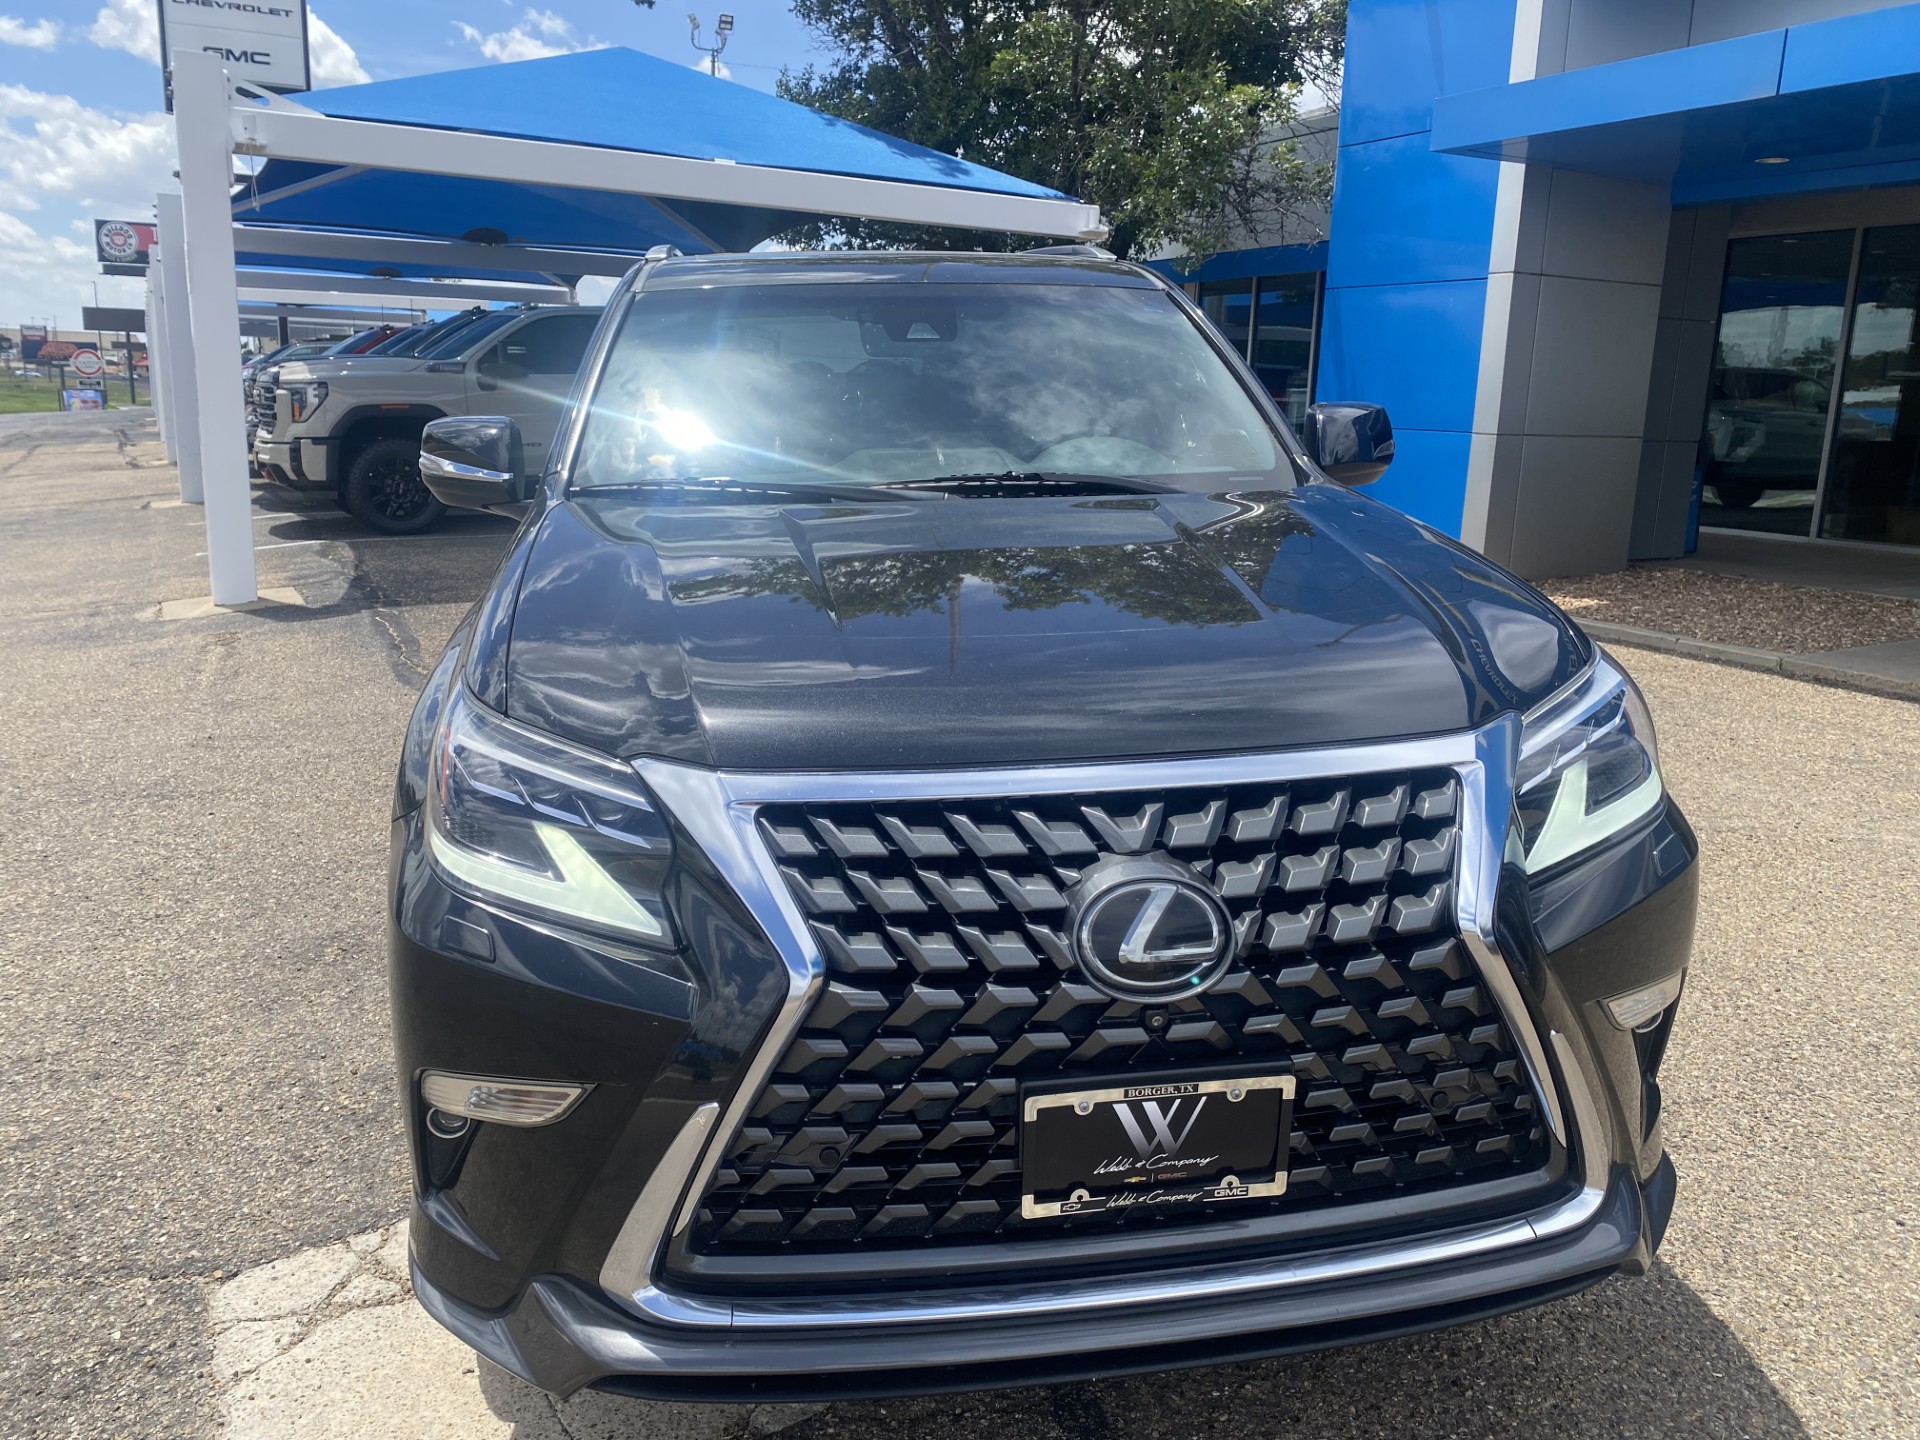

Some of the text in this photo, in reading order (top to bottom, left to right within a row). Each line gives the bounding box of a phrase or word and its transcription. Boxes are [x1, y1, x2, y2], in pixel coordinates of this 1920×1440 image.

[1127, 1084, 1194, 1098] BORGER, TX
[1093, 1155, 1132, 1174] Webb
[1145, 1153, 1220, 1168] Company
[1157, 1171, 1188, 1180] GMC
[1106, 1191, 1137, 1208] Webb
[1146, 1189, 1204, 1203] Company
[1214, 1187, 1249, 1197] GMC
